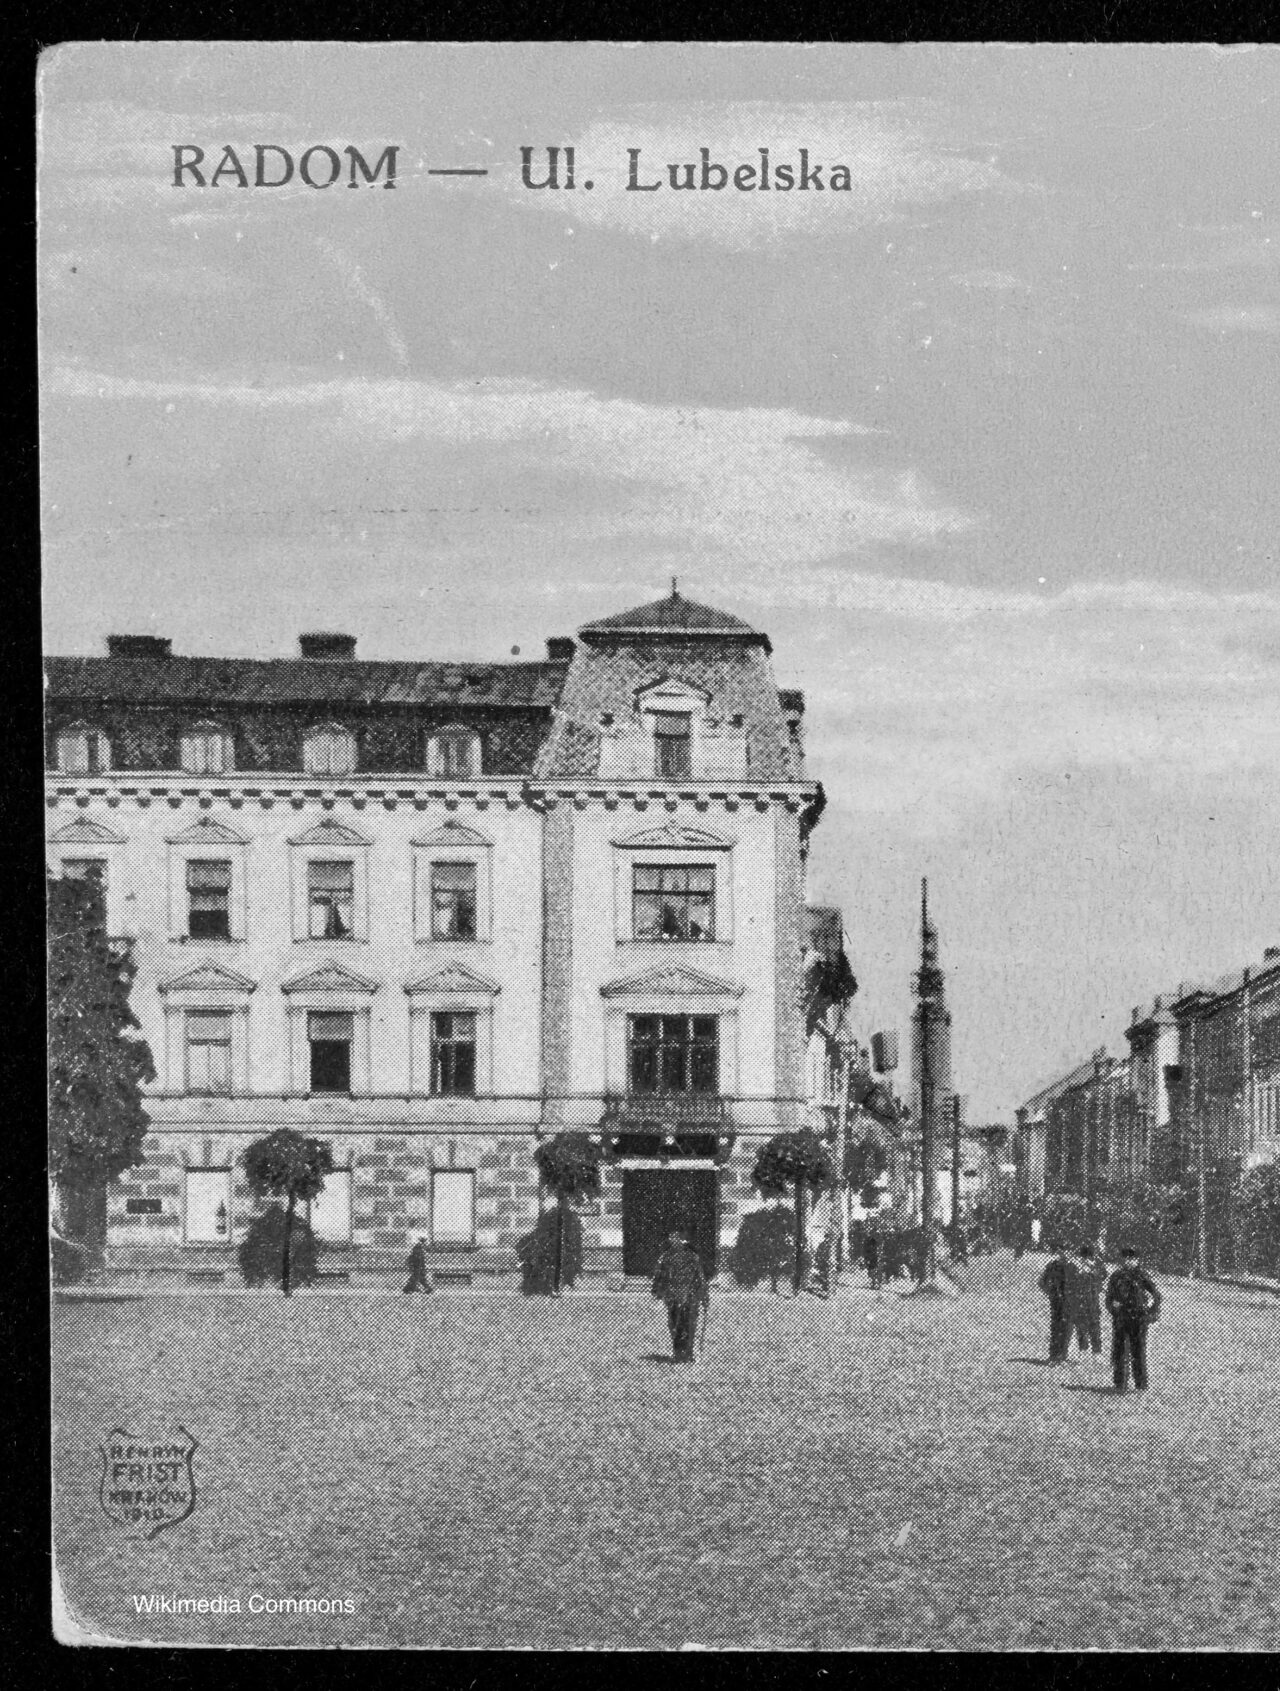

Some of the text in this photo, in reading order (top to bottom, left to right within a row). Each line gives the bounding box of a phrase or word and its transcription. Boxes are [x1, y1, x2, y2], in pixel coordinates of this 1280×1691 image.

[170, 144, 400, 189] RADOM
[519, 145, 595, 190] Ul.
[625, 147, 853, 192] Lubelska
[112, 1462, 183, 1484] FRIST
